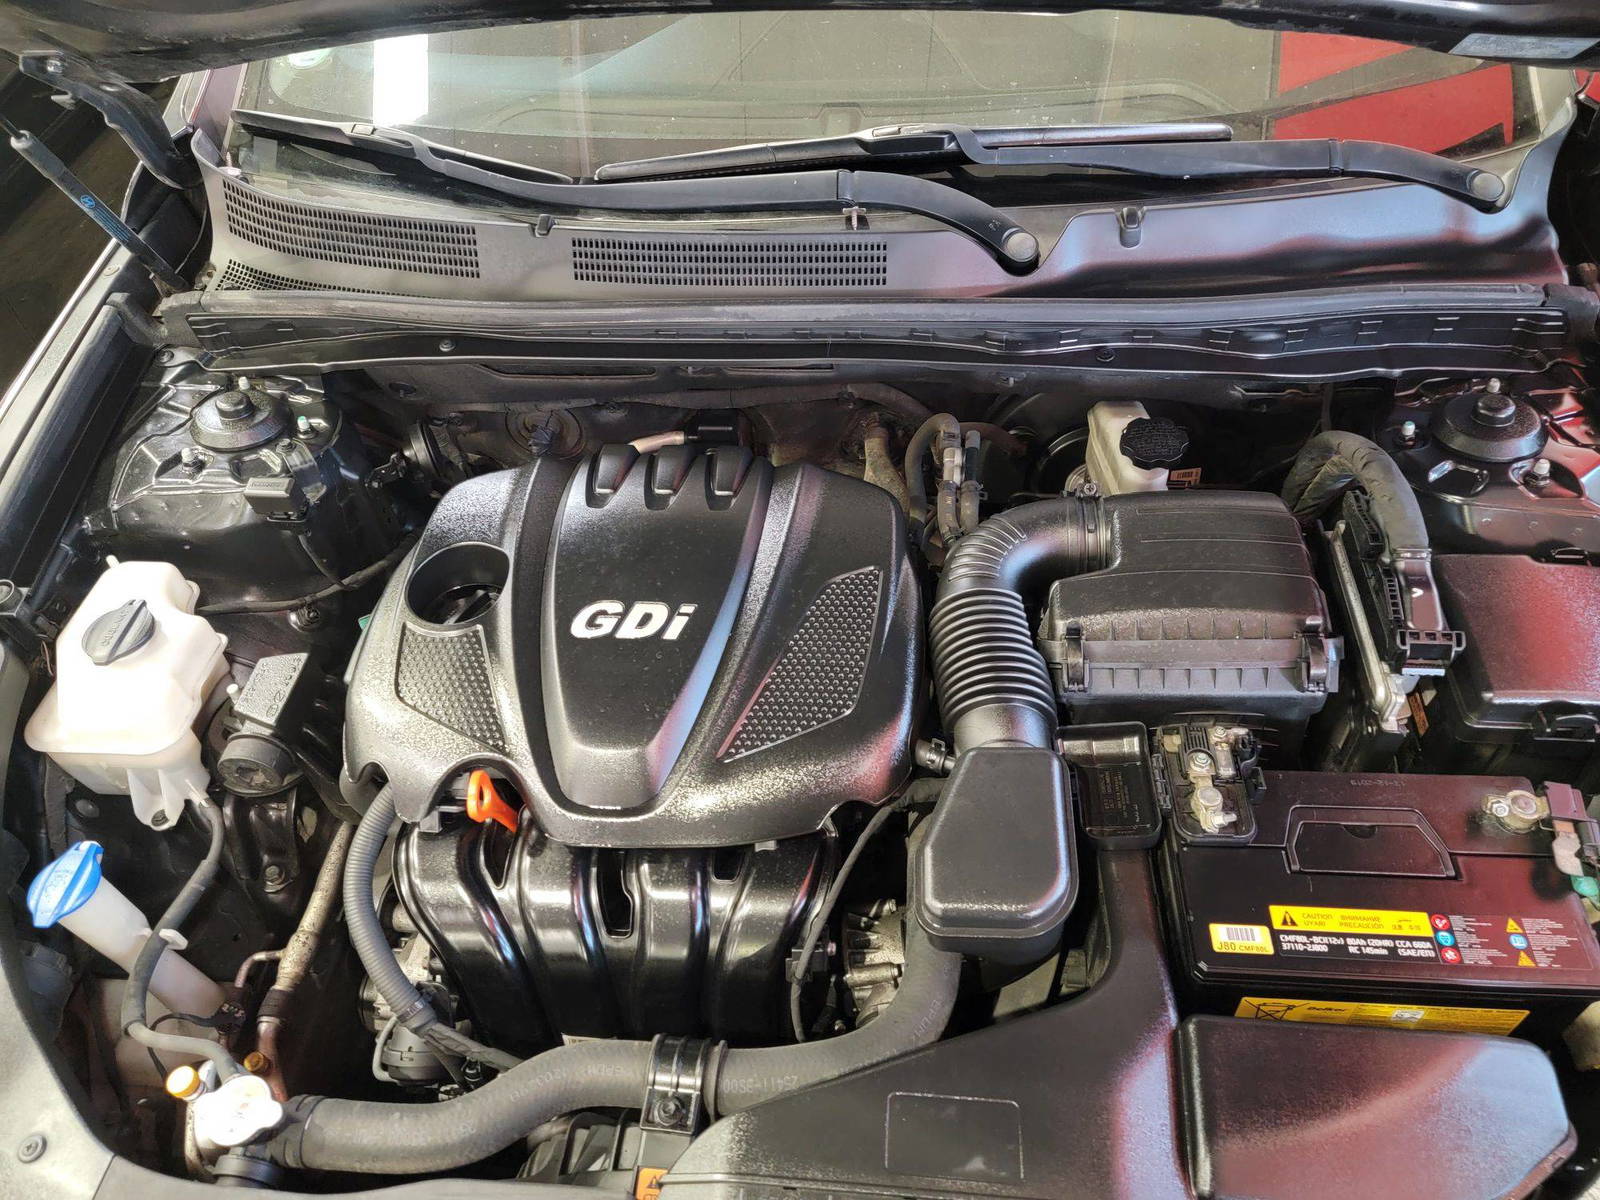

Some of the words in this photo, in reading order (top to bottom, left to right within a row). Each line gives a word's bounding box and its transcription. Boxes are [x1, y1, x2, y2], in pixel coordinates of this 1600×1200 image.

[570, 599, 698, 640] GDi
[1395, 939, 1412, 948] CCA
[1348, 945, 1361, 954] RC
